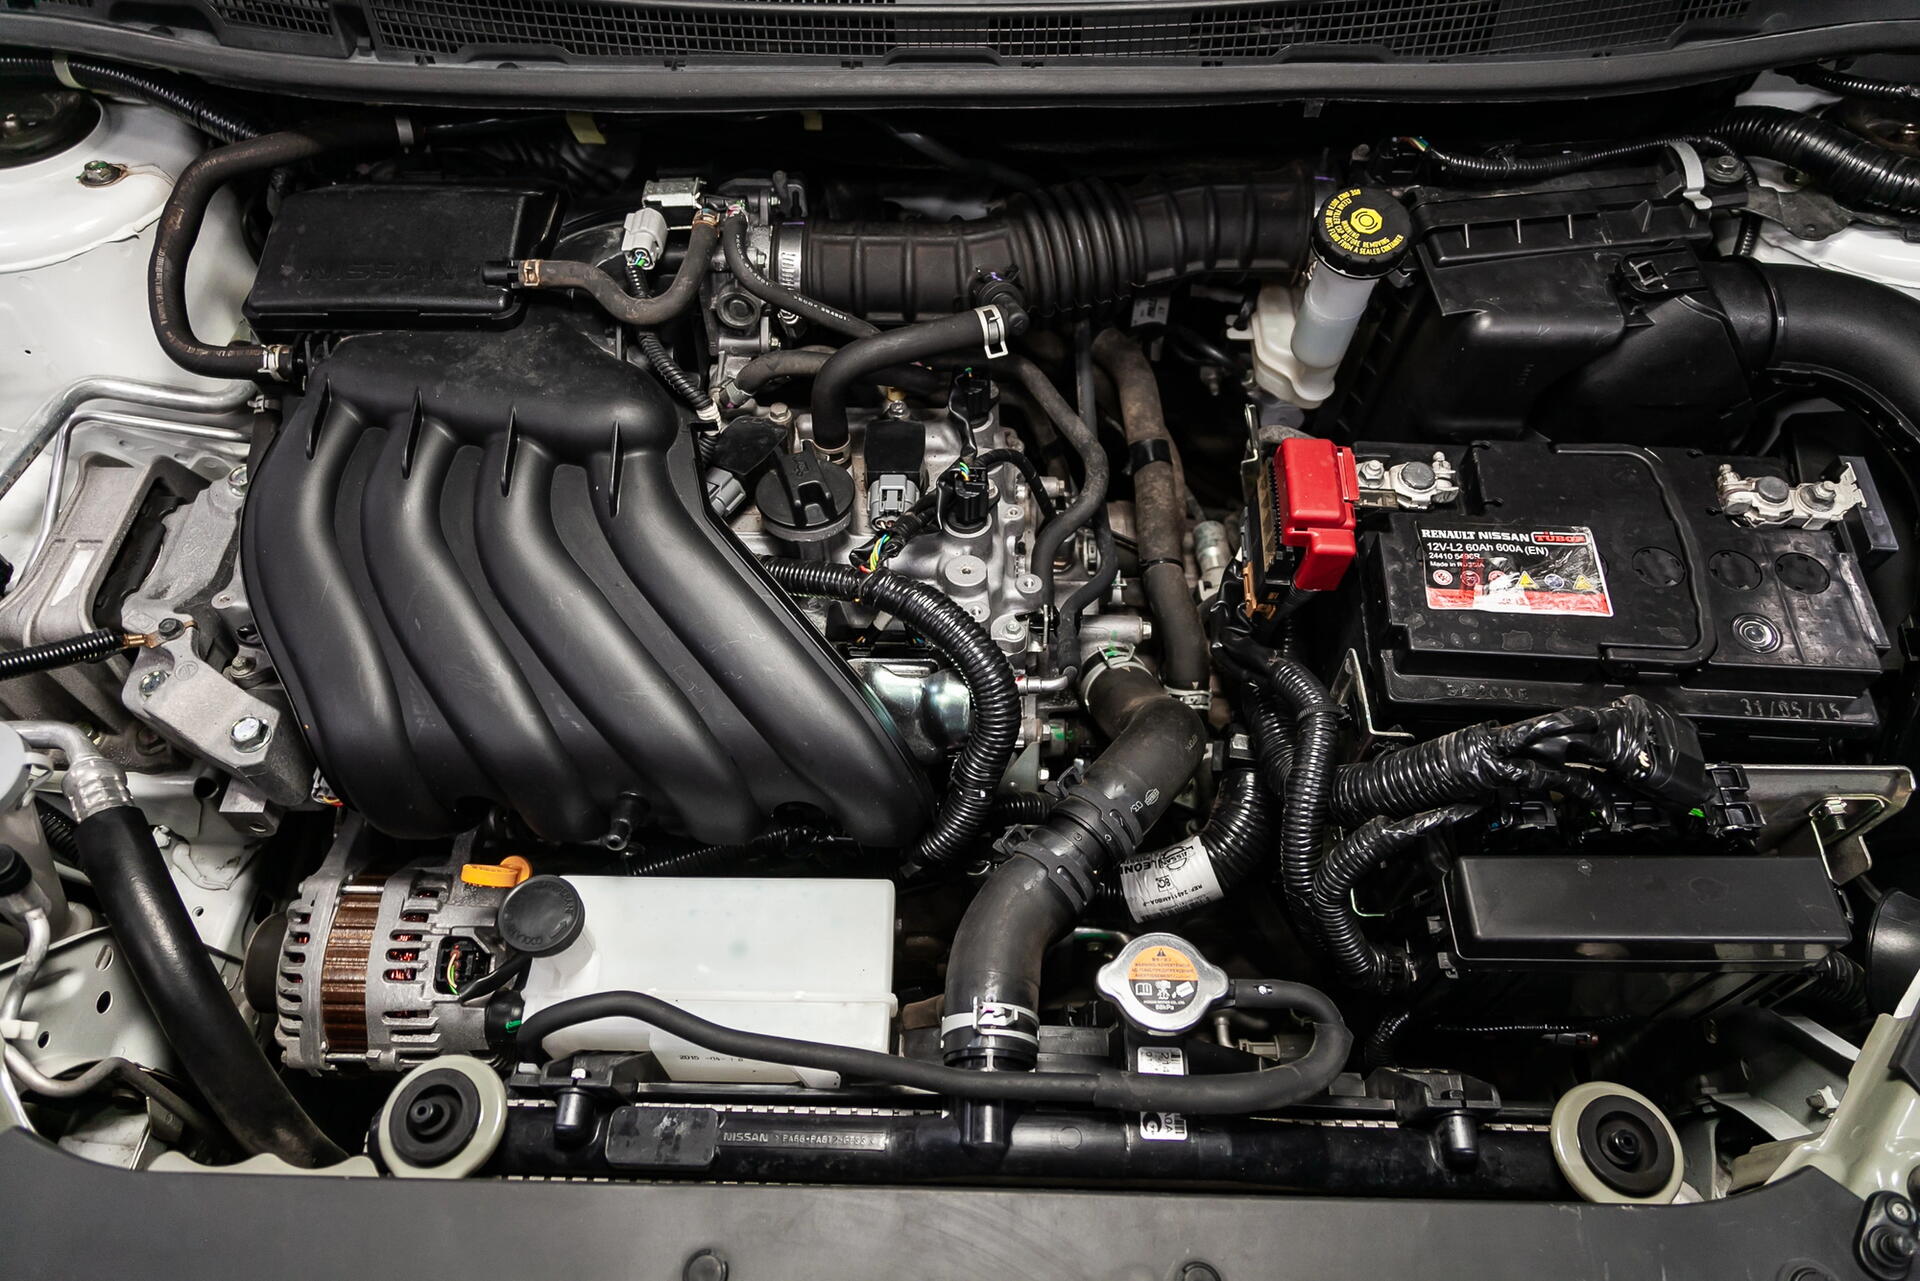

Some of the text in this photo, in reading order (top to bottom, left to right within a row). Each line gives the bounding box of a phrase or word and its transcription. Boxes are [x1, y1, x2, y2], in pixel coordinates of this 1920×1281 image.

[1338, 239, 1354, 251] FROM
[1359, 247, 1381, 256] SEALED
[297, 264, 456, 281] NISSAN
[1421, 529, 1476, 540] RENAULT
[1478, 531, 1530, 542] NISSAN
[1427, 542, 1549, 557] 12V-L2 60Ah 600A (EN)
[1428, 552, 1453, 560] 24410
[723, 1132, 769, 1143] NISSAN
